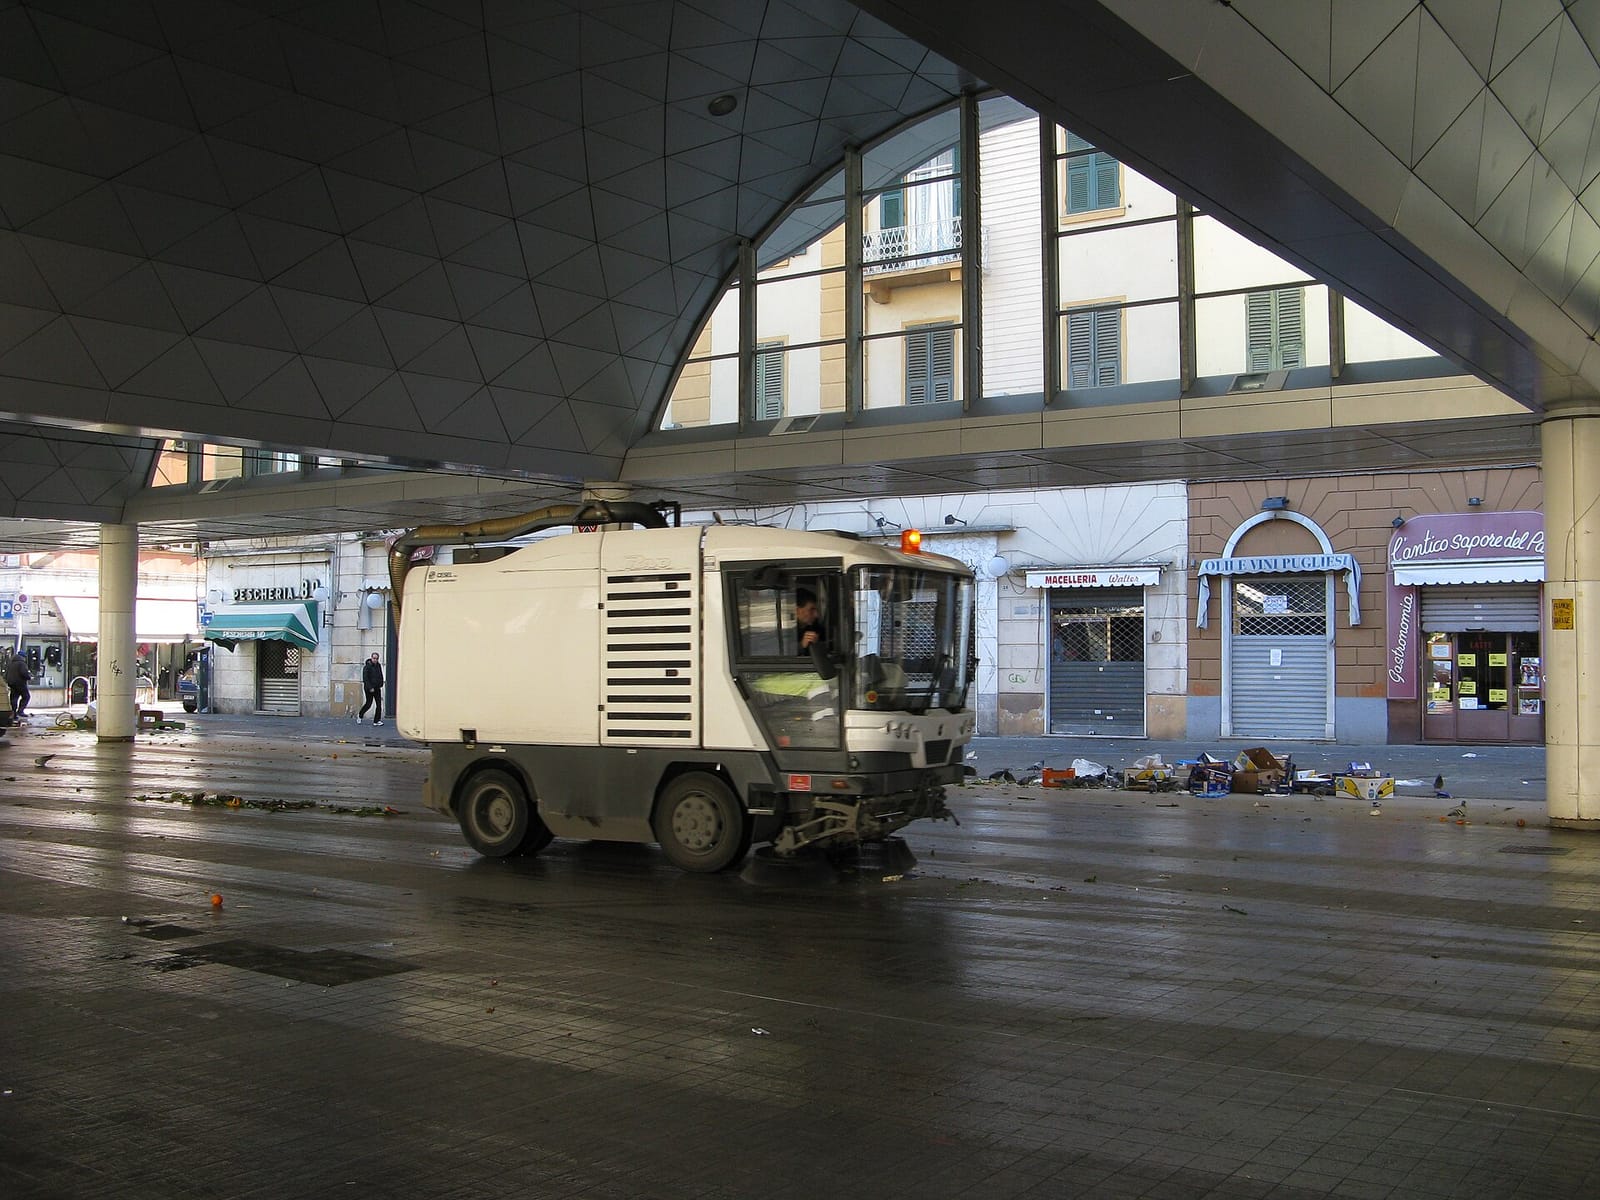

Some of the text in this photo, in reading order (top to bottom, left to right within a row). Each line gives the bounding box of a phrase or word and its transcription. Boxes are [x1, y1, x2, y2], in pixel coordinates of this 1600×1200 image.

[1503, 530, 1529, 549] del
[1250, 557, 1278, 570] VINI
[1282, 555, 1346, 569] PUGLIESI
[1045, 574, 1140, 585] MACELLERIA Walter
[233, 587, 295, 601] PESCHERIA
[0, 602, 12, 617] P
[1389, 593, 1414, 684] Gastronomia
